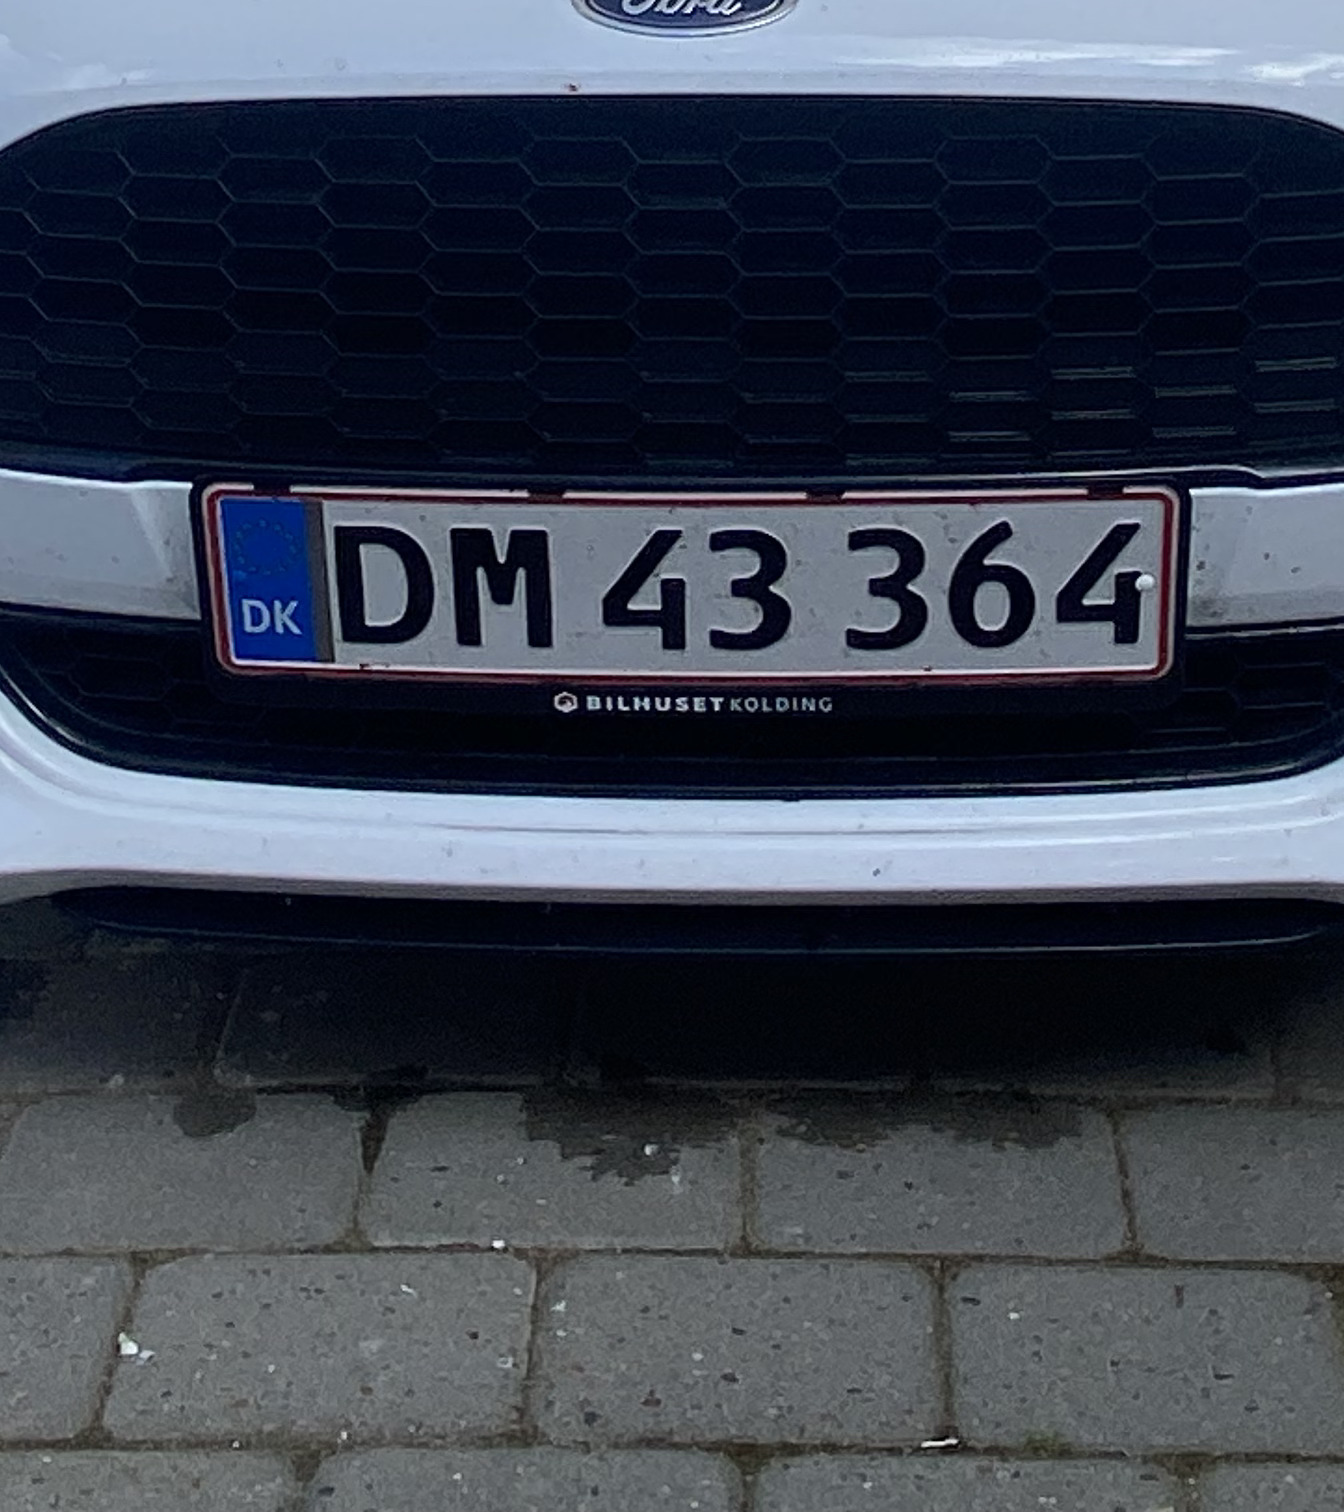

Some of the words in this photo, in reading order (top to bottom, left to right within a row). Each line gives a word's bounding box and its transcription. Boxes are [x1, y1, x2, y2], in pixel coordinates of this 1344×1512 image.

[241, 597, 303, 636] DK
[333, 524, 554, 648] DM
[601, 528, 792, 651] 43
[845, 520, 1142, 651] 364
